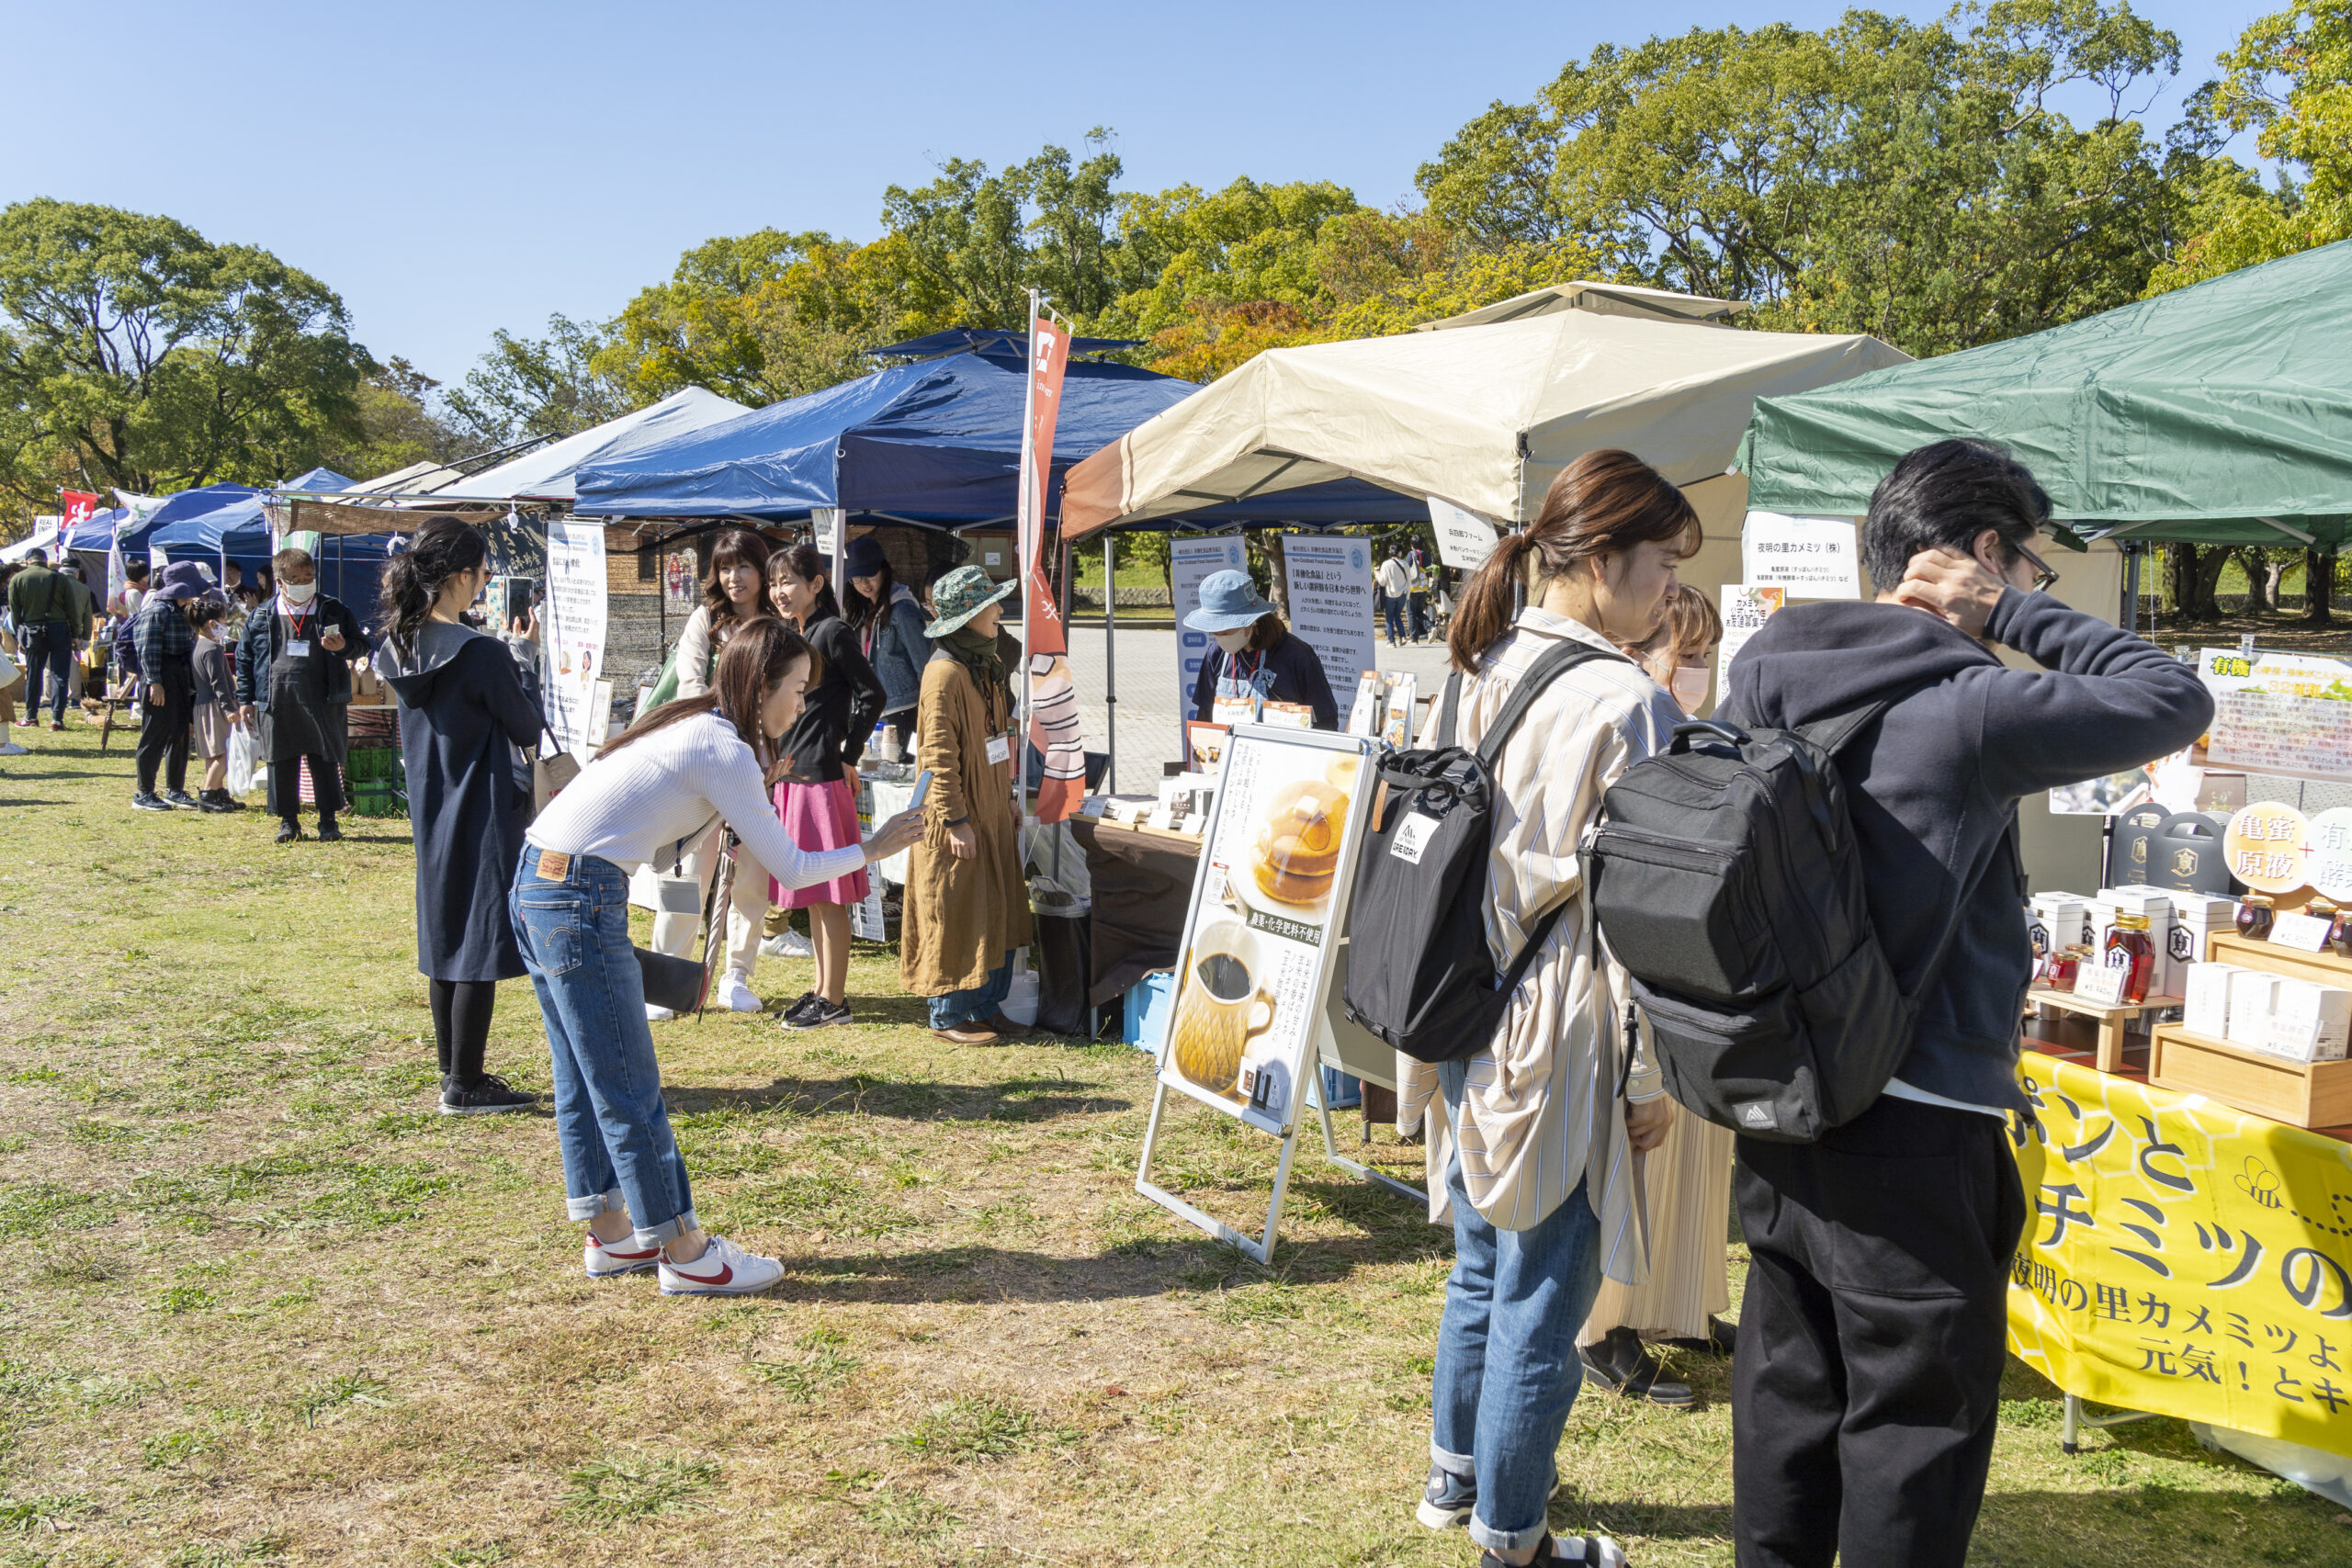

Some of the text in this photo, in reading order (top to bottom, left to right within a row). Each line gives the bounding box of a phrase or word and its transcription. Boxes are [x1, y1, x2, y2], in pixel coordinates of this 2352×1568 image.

[2211, 655, 2251, 677] 有機
[2267, 680, 2322, 697] 32種類
[990, 750, 1007, 761] SHOP
[2237, 815, 2295, 843] 亀蜜
[2321, 822, 2352, 851] 有
[2236, 850, 2294, 880] 原液
[2319, 860, 2352, 888] 酵
